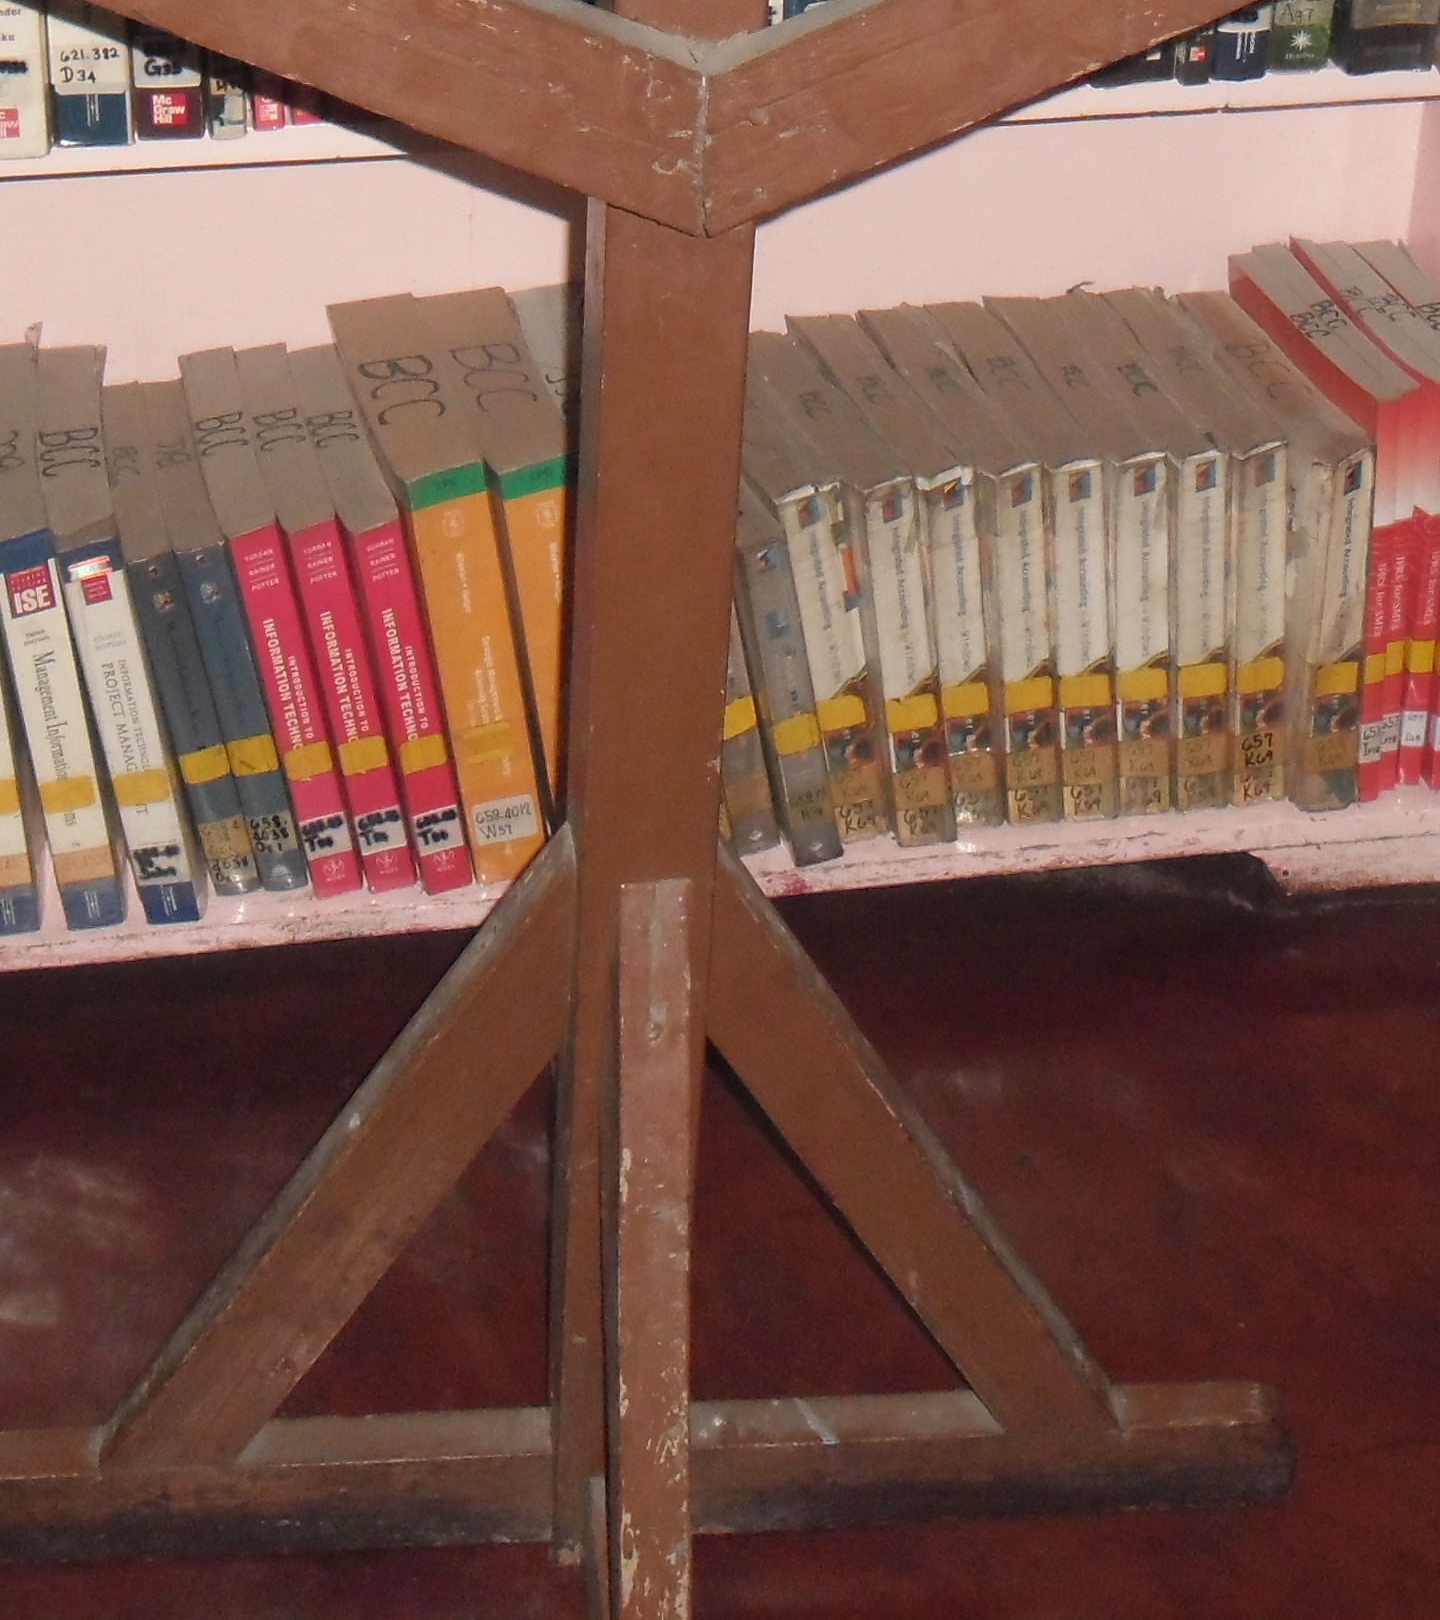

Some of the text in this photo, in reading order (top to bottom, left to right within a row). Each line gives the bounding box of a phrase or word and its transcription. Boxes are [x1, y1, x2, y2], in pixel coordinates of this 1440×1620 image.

[153, 93, 172, 106] Mc
[153, 105, 185, 117] Graw
[14, 583, 52, 615] ISE
[263, 618, 293, 702] INFORMATION
[320, 611, 348, 695] INFORMATION
[345, 648, 366, 717] INTRODUCTION
[382, 608, 408, 692] INFORMATION
[404, 645, 426, 715] INTRODUCTION
[33, 651, 56, 727] Management
[102, 661, 125, 719] PROJECT
